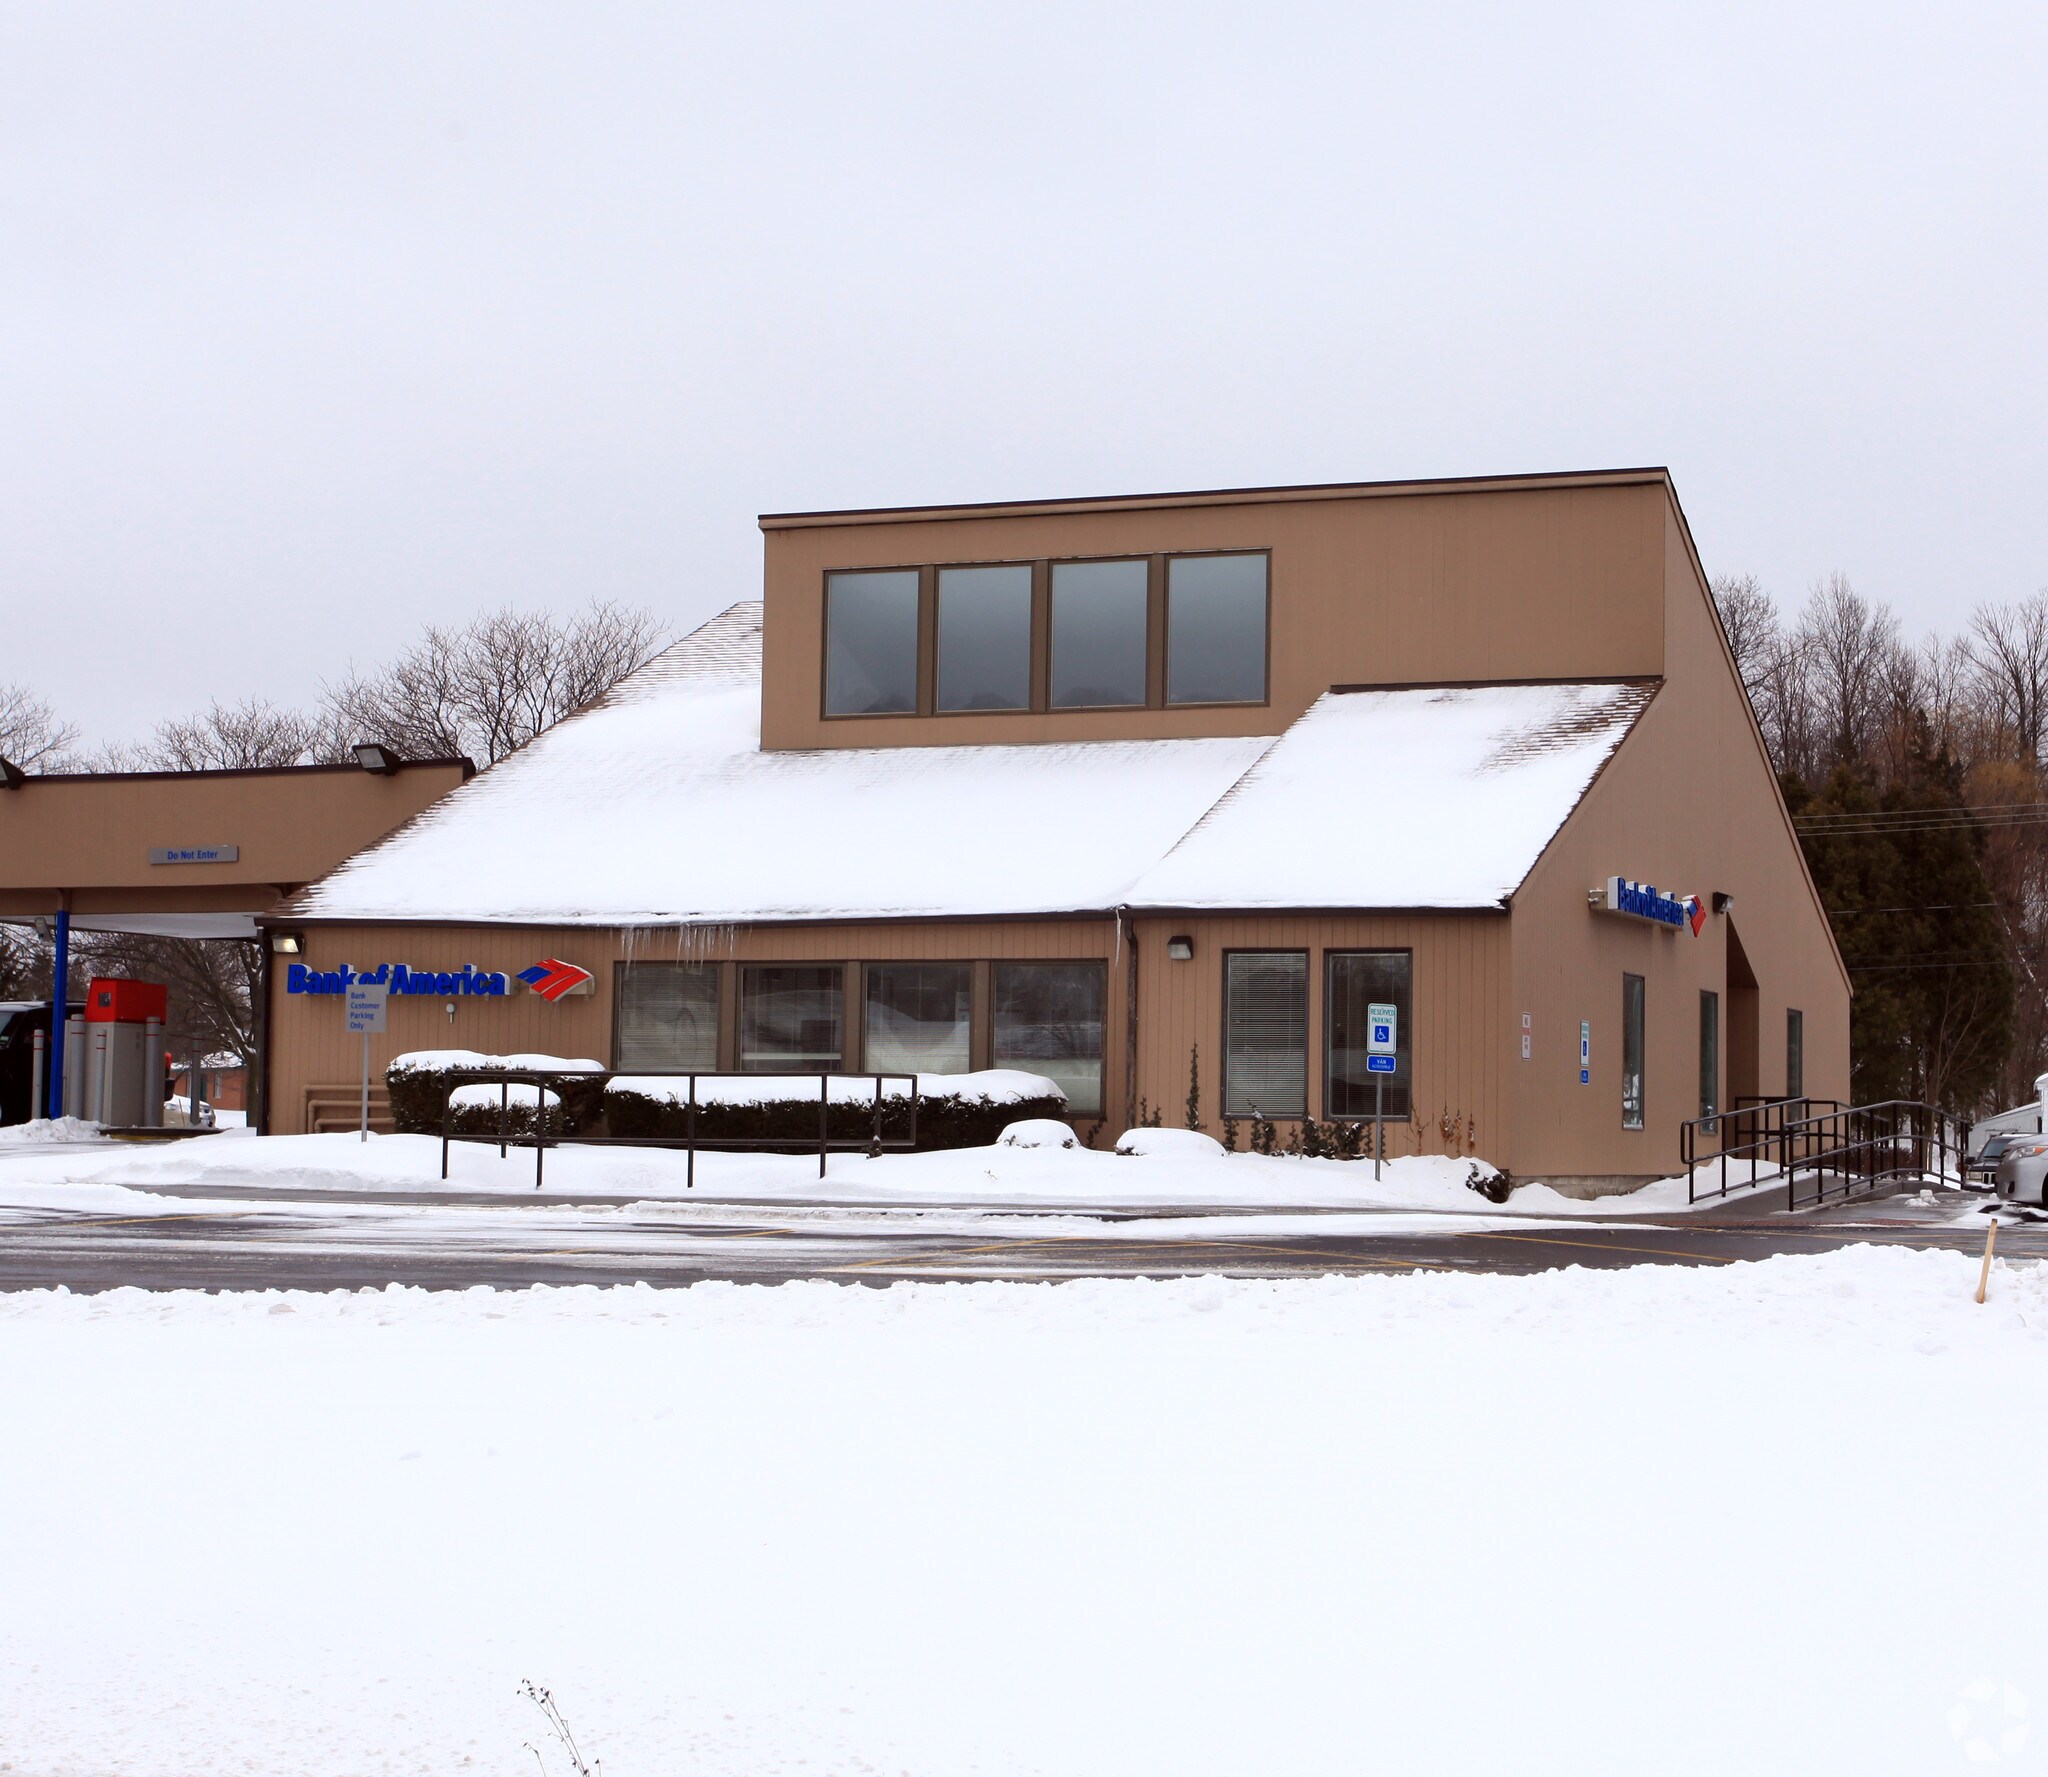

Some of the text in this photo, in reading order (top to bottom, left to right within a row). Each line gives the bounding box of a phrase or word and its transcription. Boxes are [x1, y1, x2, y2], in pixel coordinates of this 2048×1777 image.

[167, 849, 218, 860] Do Not Enter
[1617, 876, 1642, 915] Bank
[287, 964, 357, 994] Bank
[389, 964, 507, 995] America
[350, 1002, 380, 1010] Customer
[350, 1012, 374, 1021] Parking
[1370, 1008, 1395, 1016] RESERVED
[350, 1022, 364, 1030] Only
